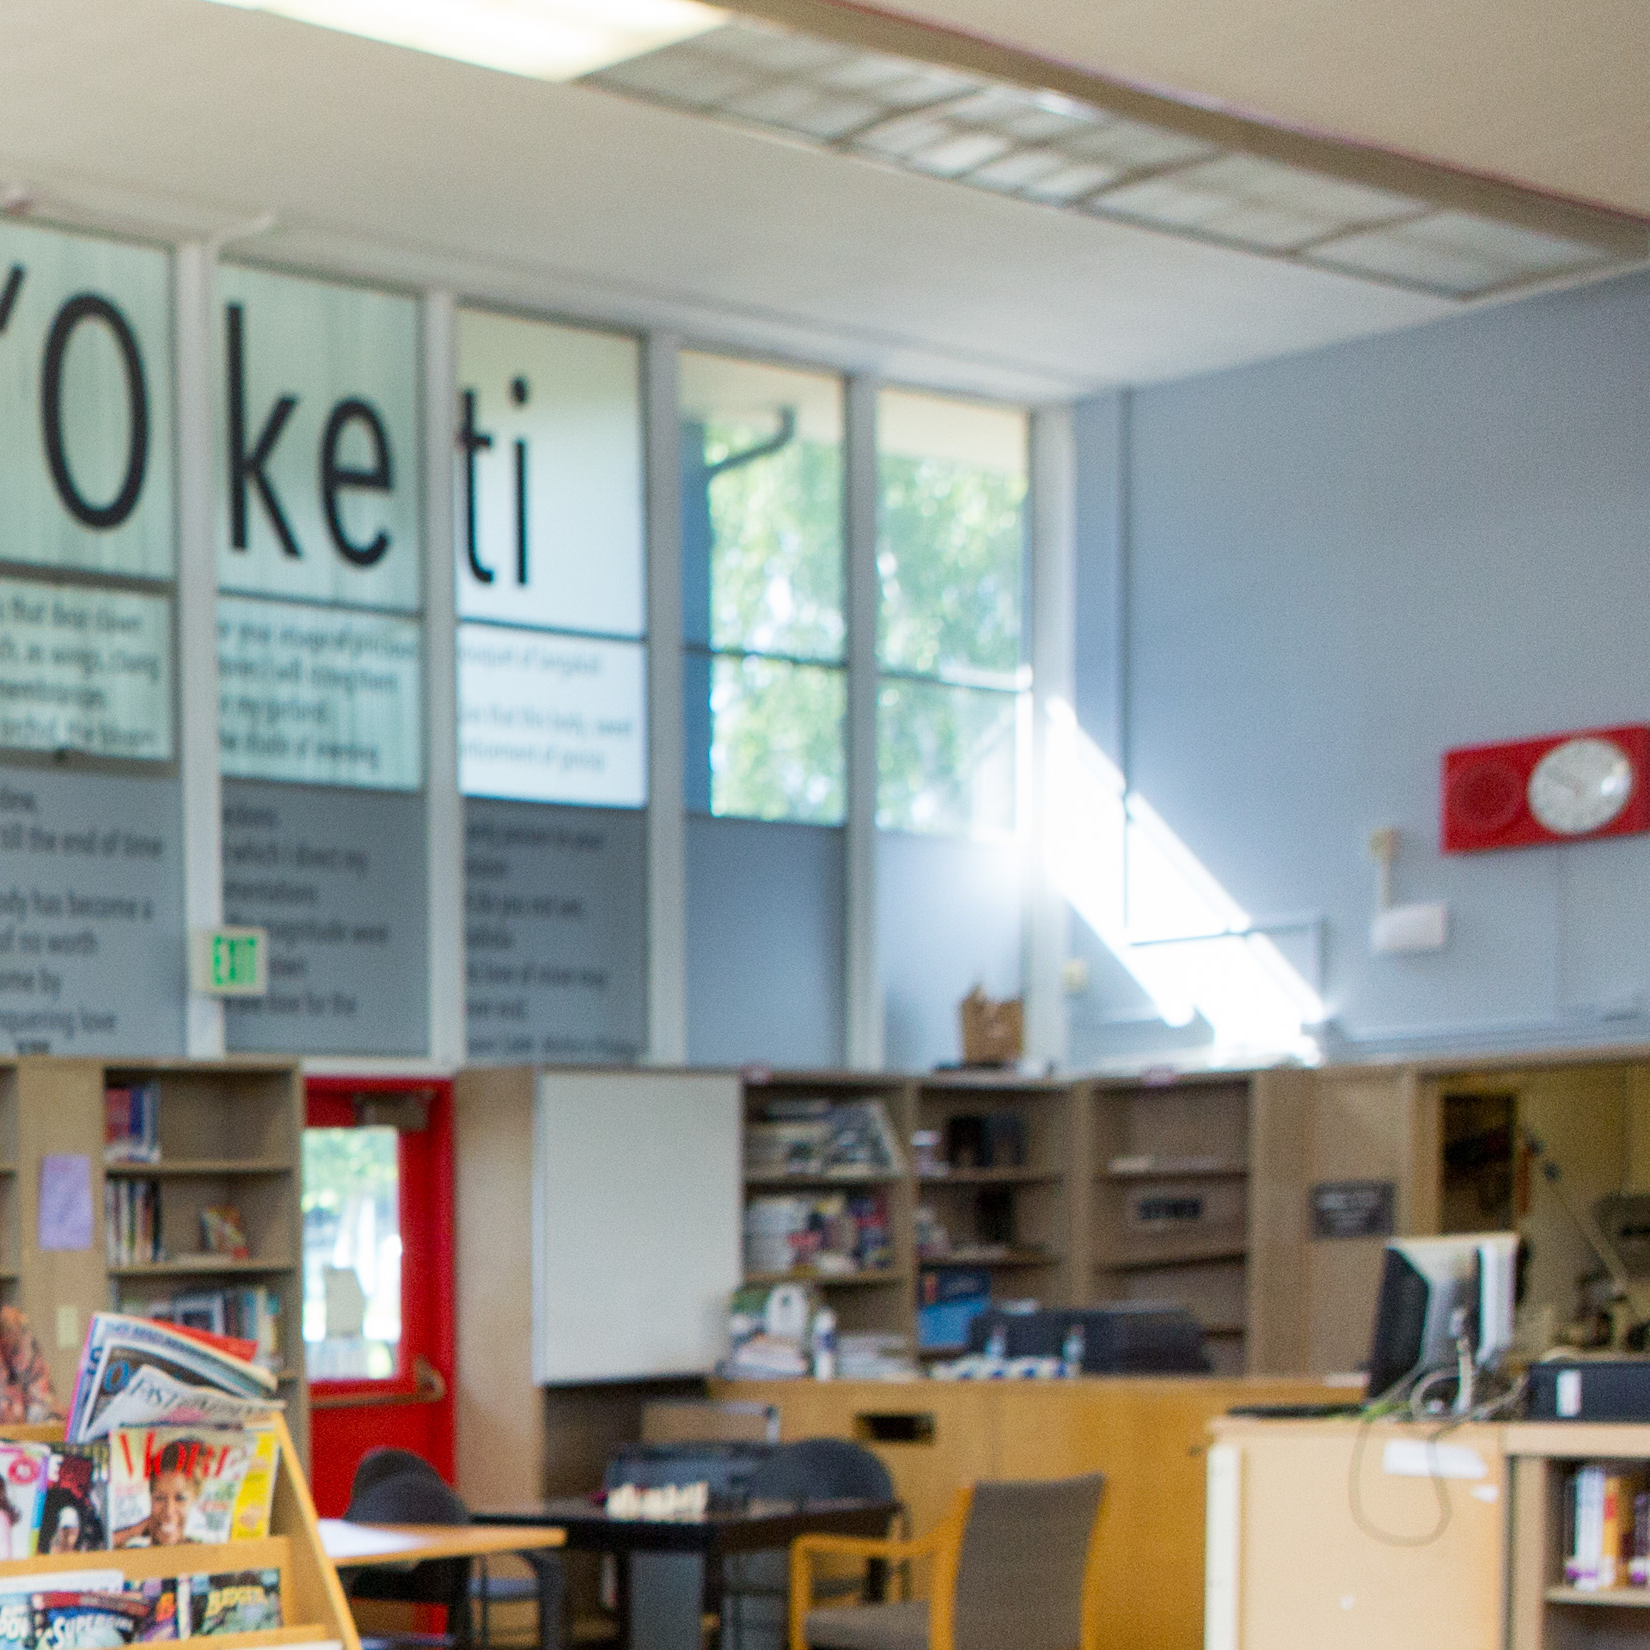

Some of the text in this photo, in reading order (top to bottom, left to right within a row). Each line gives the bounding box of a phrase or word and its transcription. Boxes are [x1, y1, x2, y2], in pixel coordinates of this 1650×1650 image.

[29, 826, 55, 853] the
[63, 829, 96, 855] end
[103, 830, 119, 857] of
[124, 832, 162, 860] time
